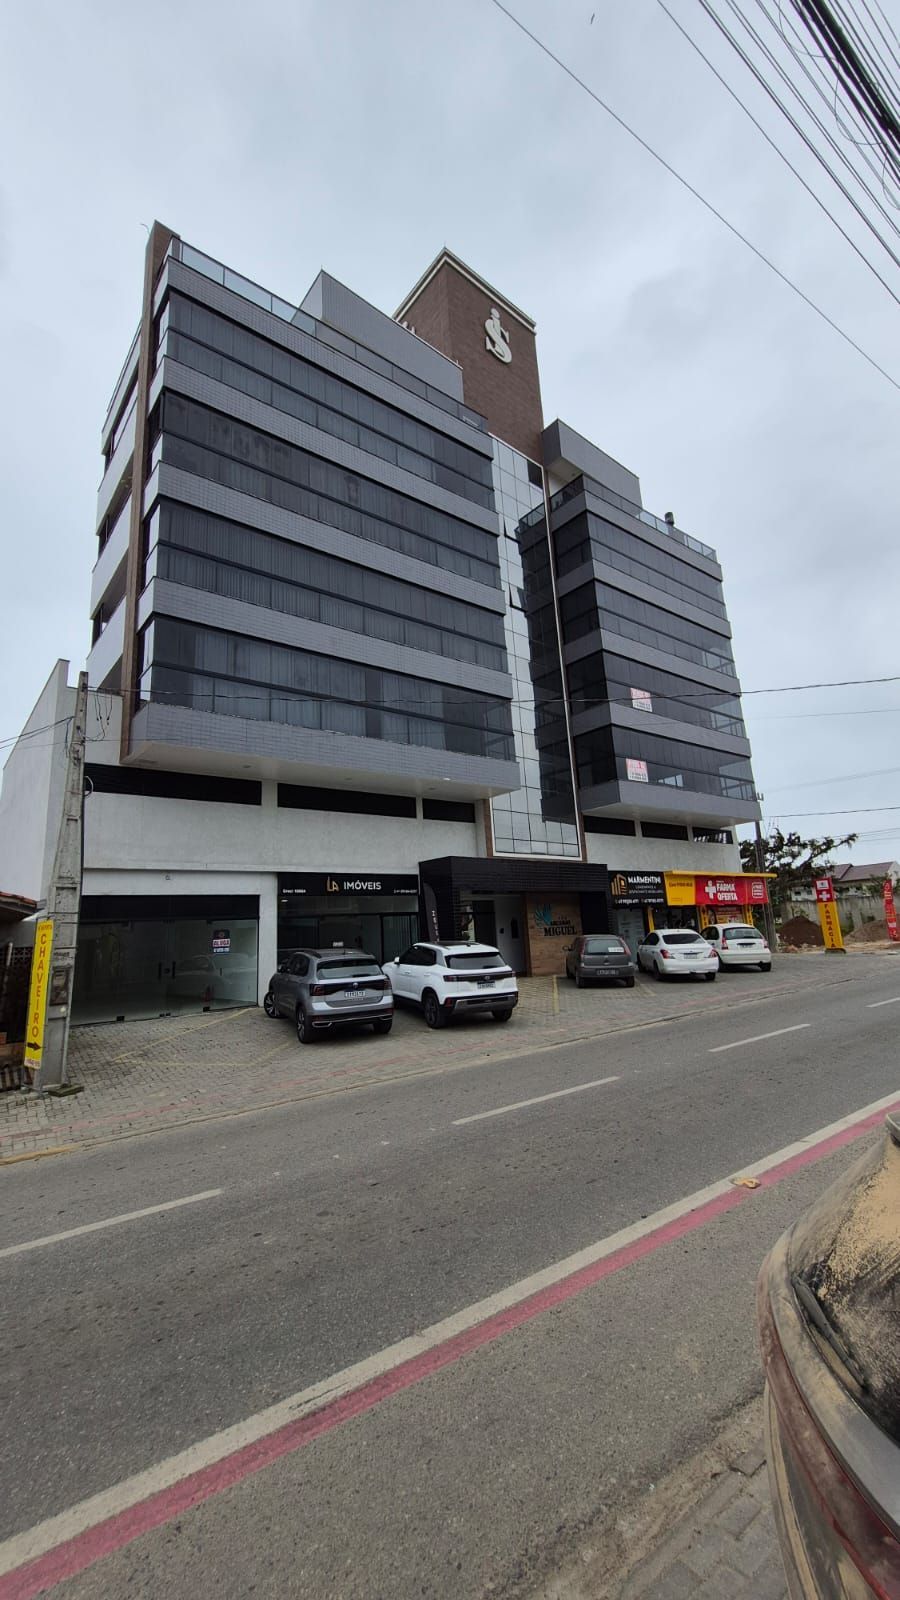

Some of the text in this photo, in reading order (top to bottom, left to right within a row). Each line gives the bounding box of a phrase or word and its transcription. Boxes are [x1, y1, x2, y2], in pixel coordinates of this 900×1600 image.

[627, 876, 662, 884] MARMENTINI
[343, 880, 382, 891] IMÓVEIS
[716, 883, 736, 892] FARMA
[717, 892, 738, 901] OFERTA
[543, 925, 577, 937] MIGUEL
[31, 933, 47, 1038] CHAVEIRO
